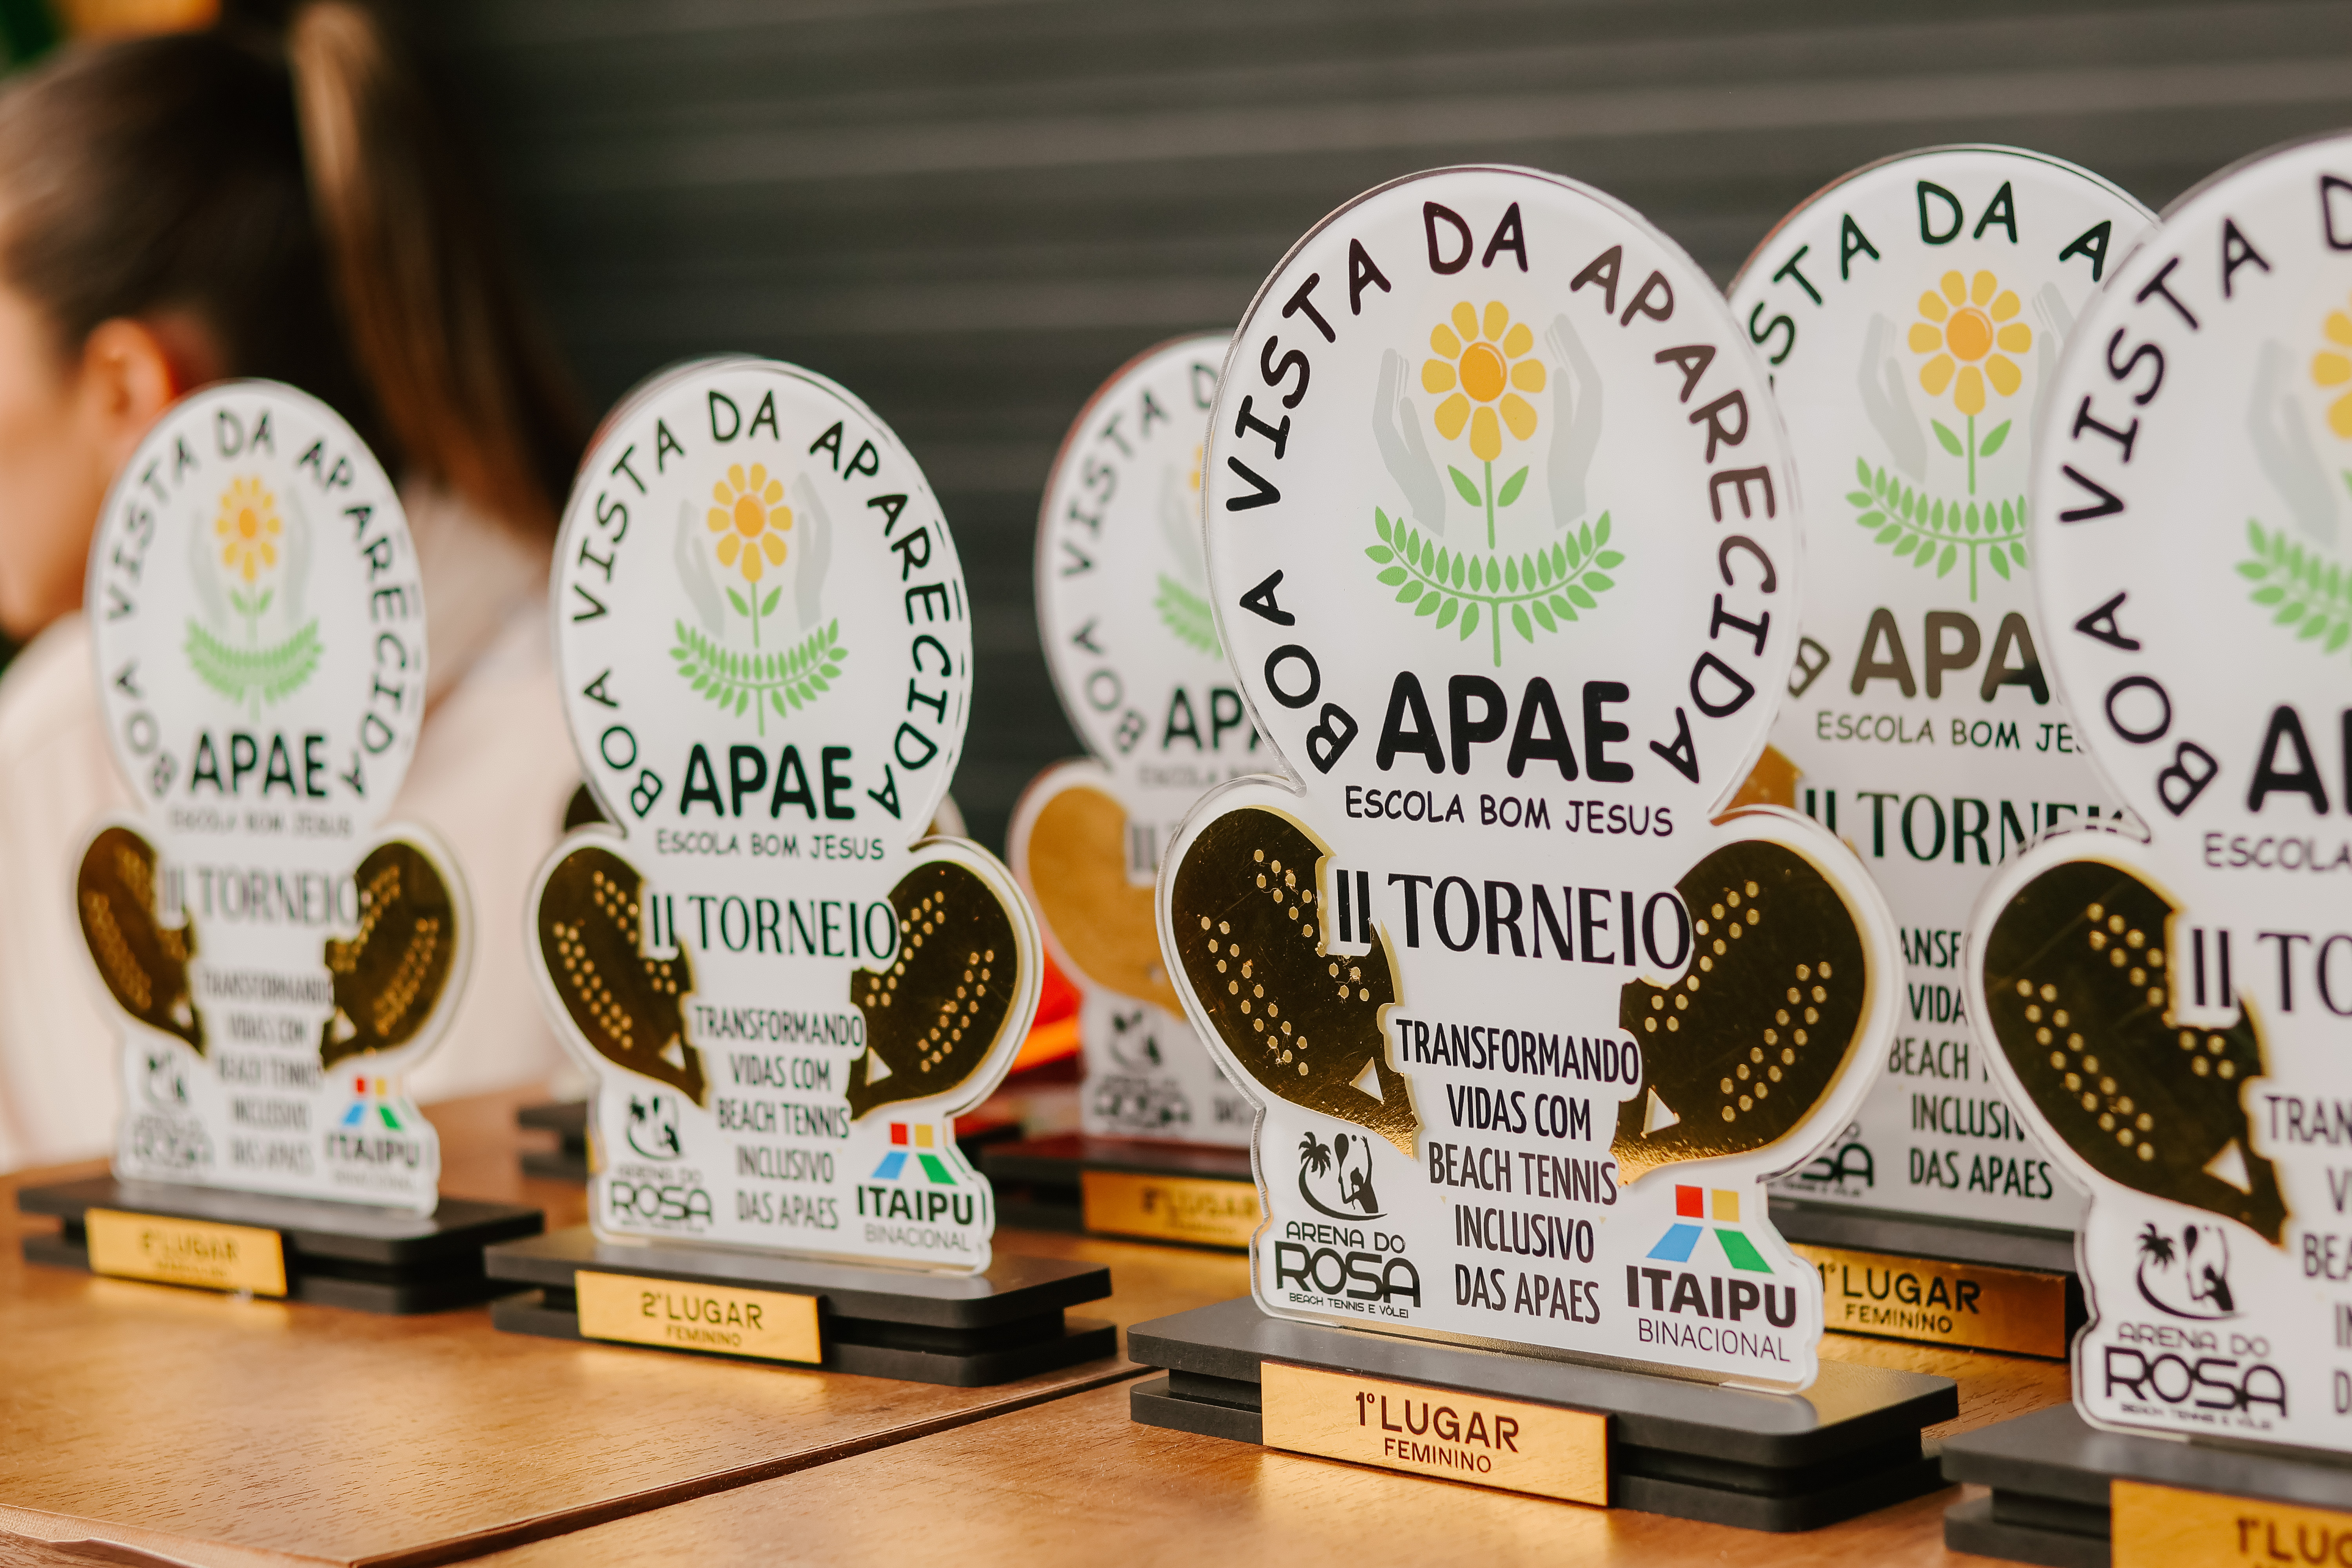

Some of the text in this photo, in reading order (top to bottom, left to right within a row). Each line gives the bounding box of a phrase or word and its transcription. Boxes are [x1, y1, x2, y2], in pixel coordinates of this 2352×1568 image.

[1917, 180, 2018, 244] DA
[2059, 216, 2271, 524] VISTA
[1060, 389, 1170, 579] VISTA
[1227, 201, 1778, 784] BOA VISTA DA APARECIDA
[106, 409, 407, 800] BOA VISTA DA APARECIDA
[573, 390, 953, 820] BOA VISTA DA APARECIDA
[1072, 621, 1147, 755] BOA
[2075, 591, 2219, 817] BOA
[1376, 671, 1634, 782] APAE
[1817, 711, 1934, 744] ESCOLA
[1952, 719, 2020, 749] BOM
[191, 732, 327, 798] APAE
[679, 744, 856, 820] APAE
[1345, 785, 1673, 837] ESCOLA BOM JESUS
[658, 828, 885, 860] ESCOLA BOM JESUS
[652, 894, 896, 960] II TORNEIO
[1337, 869, 1691, 969] II TORNEIO
[2193, 927, 2231, 1009] II
[694, 1006, 862, 1047] TRANSFORMANDO
[1396, 1019, 1639, 1085] TRANSFORMANDO
[730, 1054, 831, 1091] VIDAS COM
[717, 1099, 849, 1138] BEACH TENNIS
[1446, 1084, 1591, 1141] VIDAS COM
[737, 1146, 834, 1182] INCLUSIVO
[1429, 1142, 1617, 1205] BEACH TENNIS
[1910, 1148, 1959, 1189] DAS
[1969, 1154, 2054, 1200] APAES
[611, 1180, 712, 1225] ROSA
[737, 1190, 838, 1229] DAS APAES
[858, 1185, 973, 1225] ITAIPU
[866, 1223, 971, 1252] BINACIONAL
[1287, 1221, 1405, 1253] ARENA DO
[1454, 1204, 1594, 1263] INCLUSIVO
[1275, 1241, 1421, 1307] ROSA
[1455, 1264, 1600, 1325] DAS APAES
[1626, 1265, 1796, 1328] ITAIPU
[1844, 1265, 1981, 1314] LUGAR
[667, 1296, 762, 1330] LUGAR
[1289, 1293, 1408, 1318] BEACH TENNIS E VÔLEI
[1846, 1303, 1952, 1334] FEMININO
[666, 1324, 742, 1347] FEMININO
[1639, 1318, 1790, 1363] BINACIONAL
[2118, 1322, 2270, 1357] ARENA DO
[2105, 1346, 2287, 1417] ROSA
[1381, 1395, 1519, 1453] LUGAR
[1385, 1437, 1491, 1472] FEMININO
